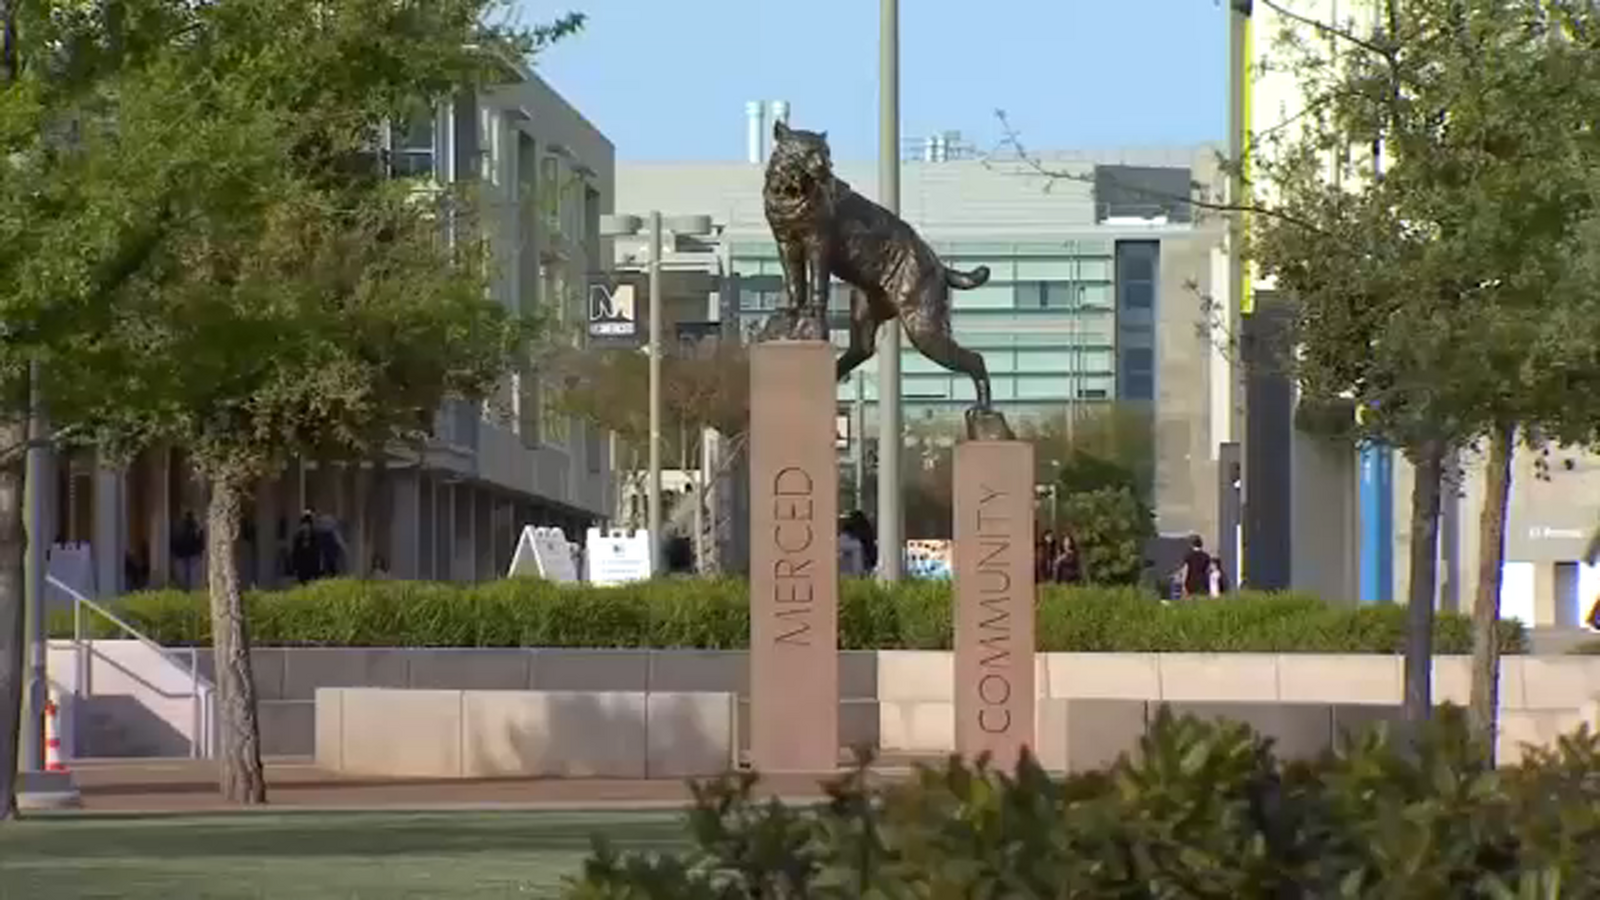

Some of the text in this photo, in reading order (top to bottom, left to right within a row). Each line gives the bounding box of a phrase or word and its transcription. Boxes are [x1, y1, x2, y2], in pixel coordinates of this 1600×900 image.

[589, 284, 635, 321] M
[774, 466, 813, 646] MERCED
[977, 484, 1010, 734] COMMUNITY
